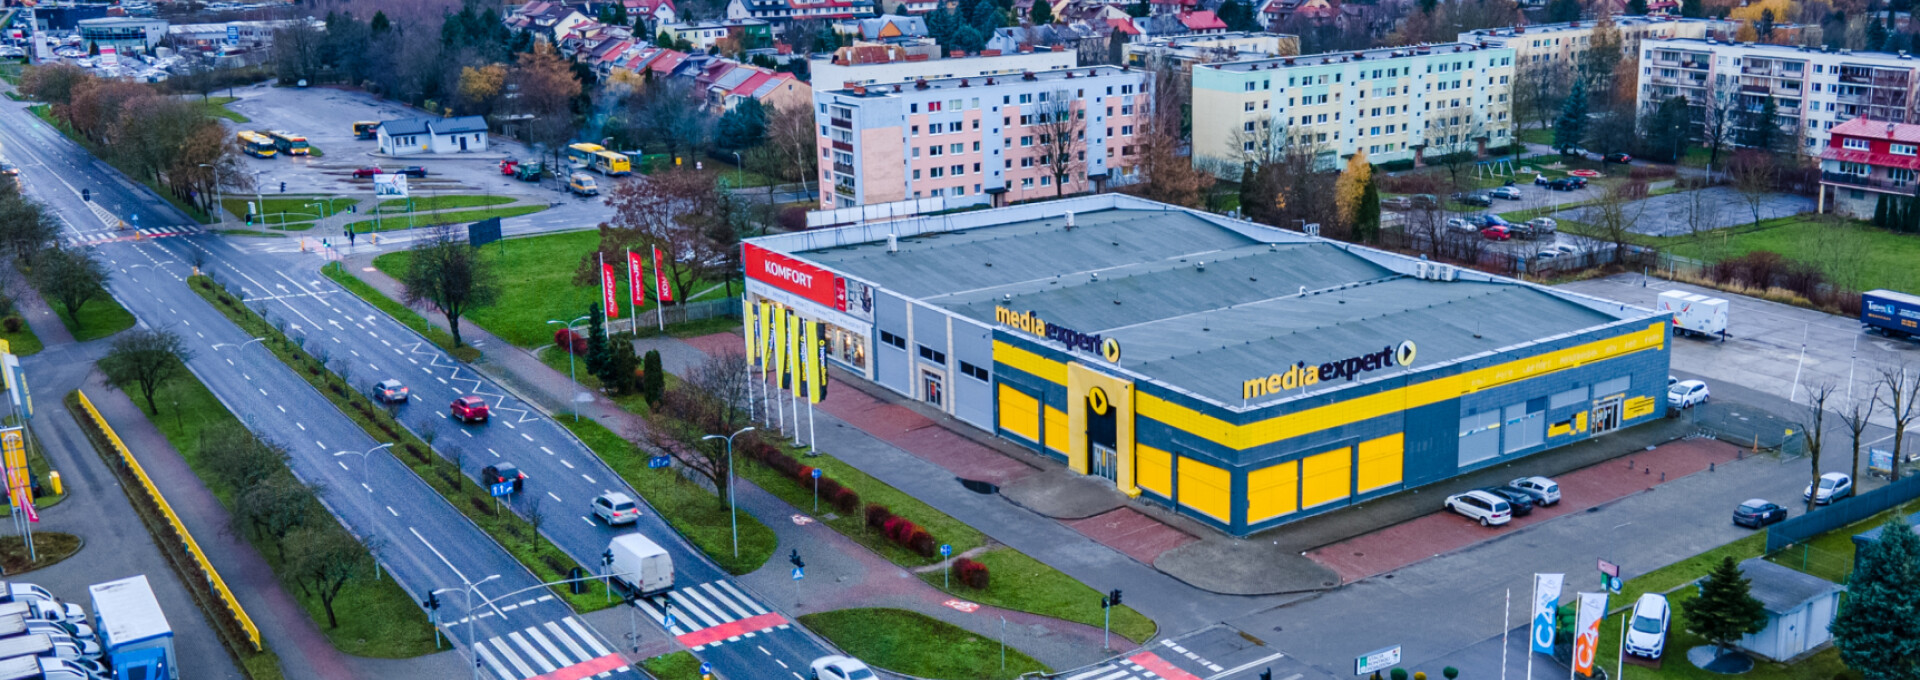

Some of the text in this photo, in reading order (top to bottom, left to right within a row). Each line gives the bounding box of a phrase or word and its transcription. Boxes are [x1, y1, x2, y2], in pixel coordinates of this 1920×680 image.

[765, 260, 813, 288] KOMFORT
[995, 305, 1104, 356] mediaexpert
[1243, 345, 1393, 399] mediaexpert
[1535, 604, 1554, 648] C4
[1577, 626, 1598, 669] C4
